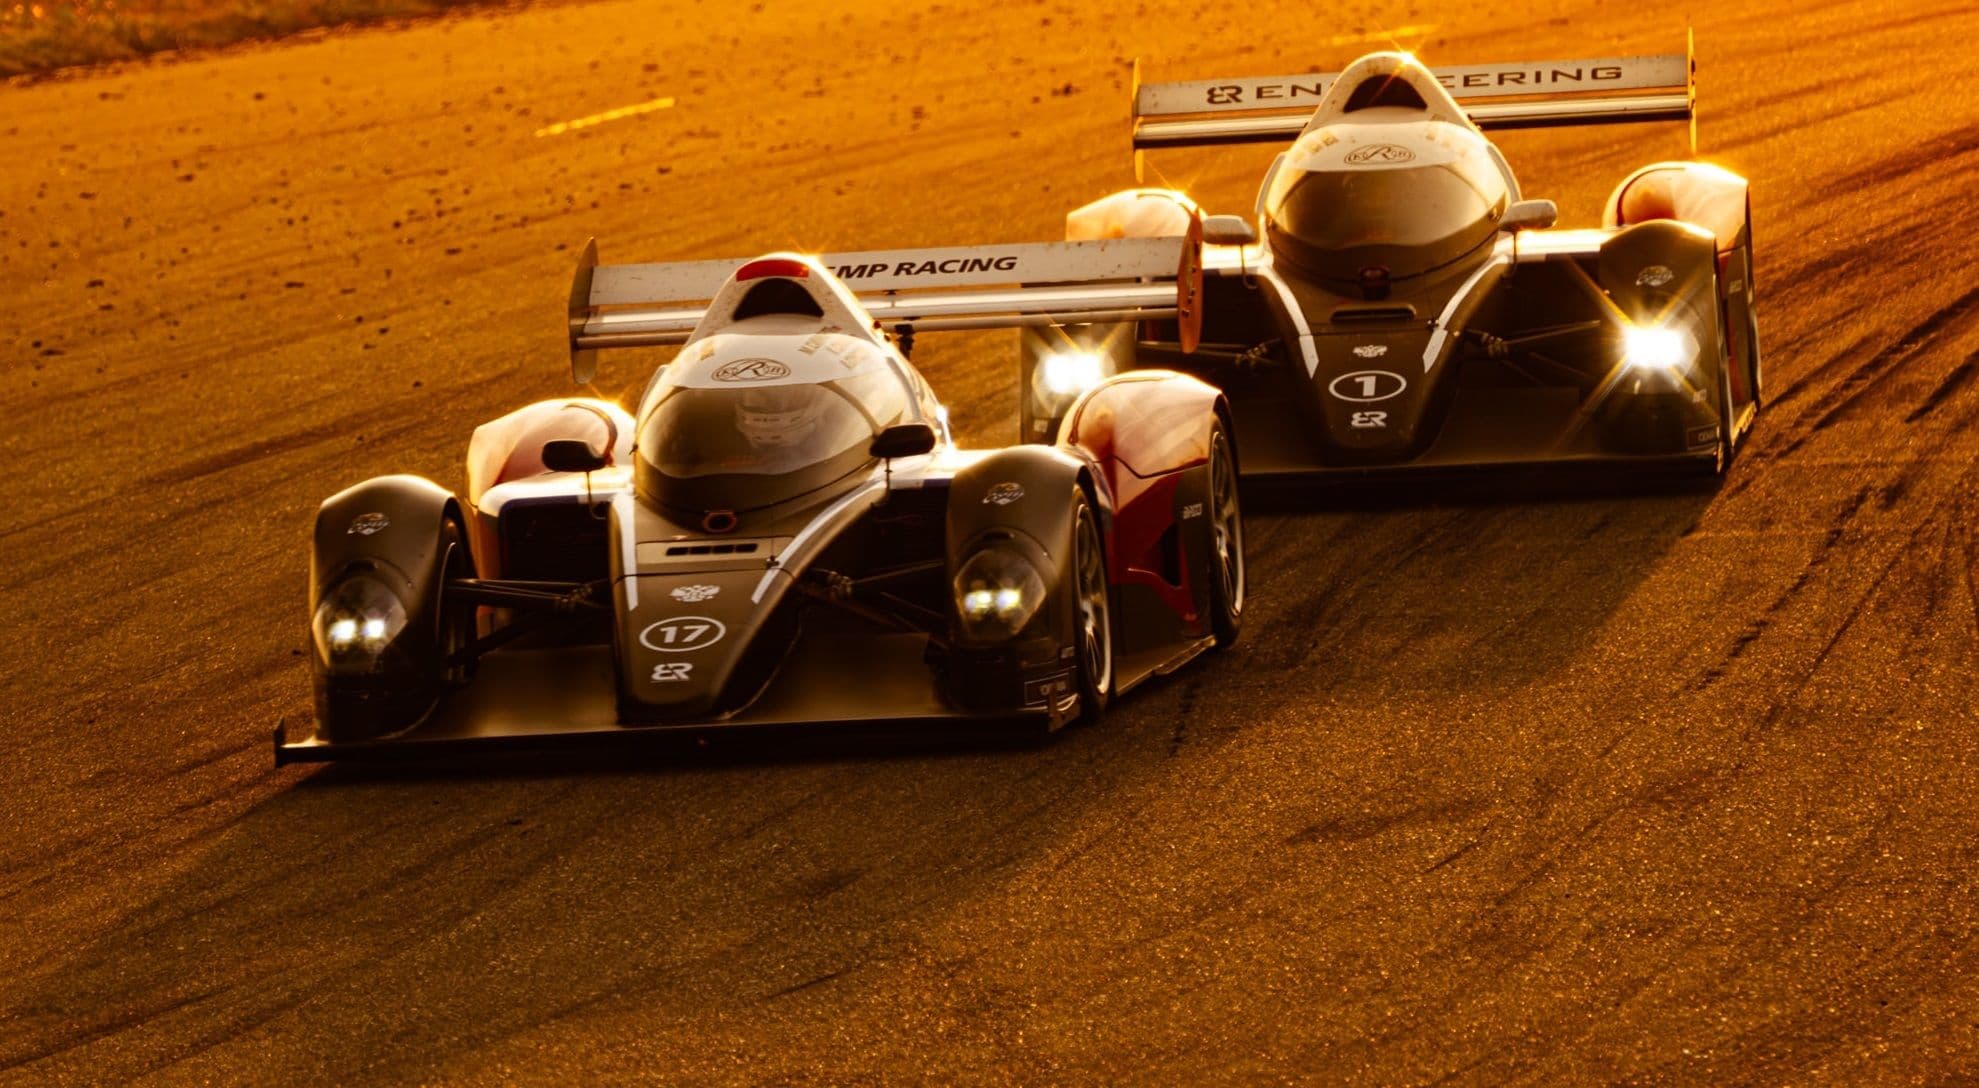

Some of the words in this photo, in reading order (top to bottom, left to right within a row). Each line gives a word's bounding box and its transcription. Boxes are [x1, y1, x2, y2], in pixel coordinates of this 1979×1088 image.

[893, 256, 1018, 276] RACING
[1354, 375, 1377, 397] 1
[660, 625, 711, 644] 17
